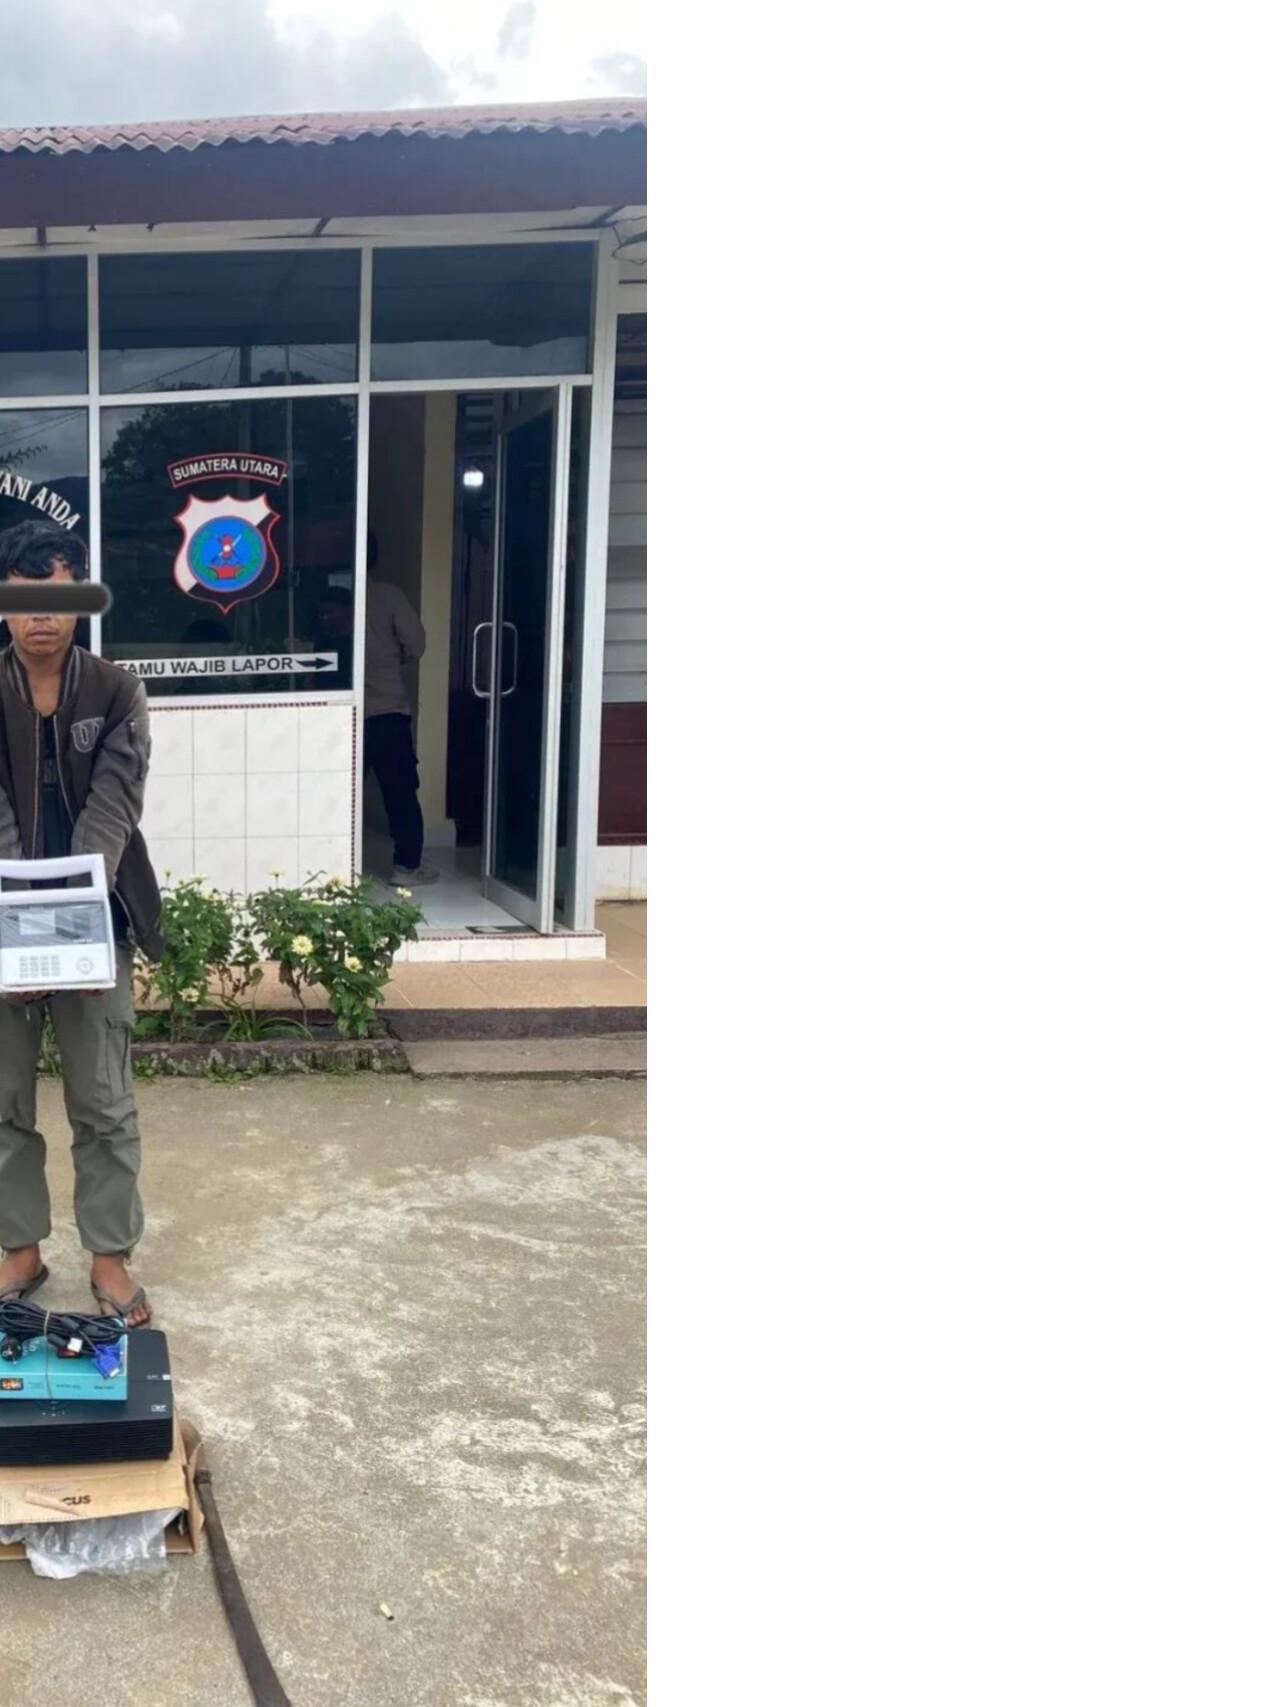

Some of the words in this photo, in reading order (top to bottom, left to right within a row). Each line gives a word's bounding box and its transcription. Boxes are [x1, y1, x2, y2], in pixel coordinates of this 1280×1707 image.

[173, 458, 238, 482] SUMATERA
[239, 458, 280, 479] UTARA
[30, 485, 81, 530] ANDA
[170, 660, 226, 674] WAJIB
[231, 657, 293, 673] LAPOR
